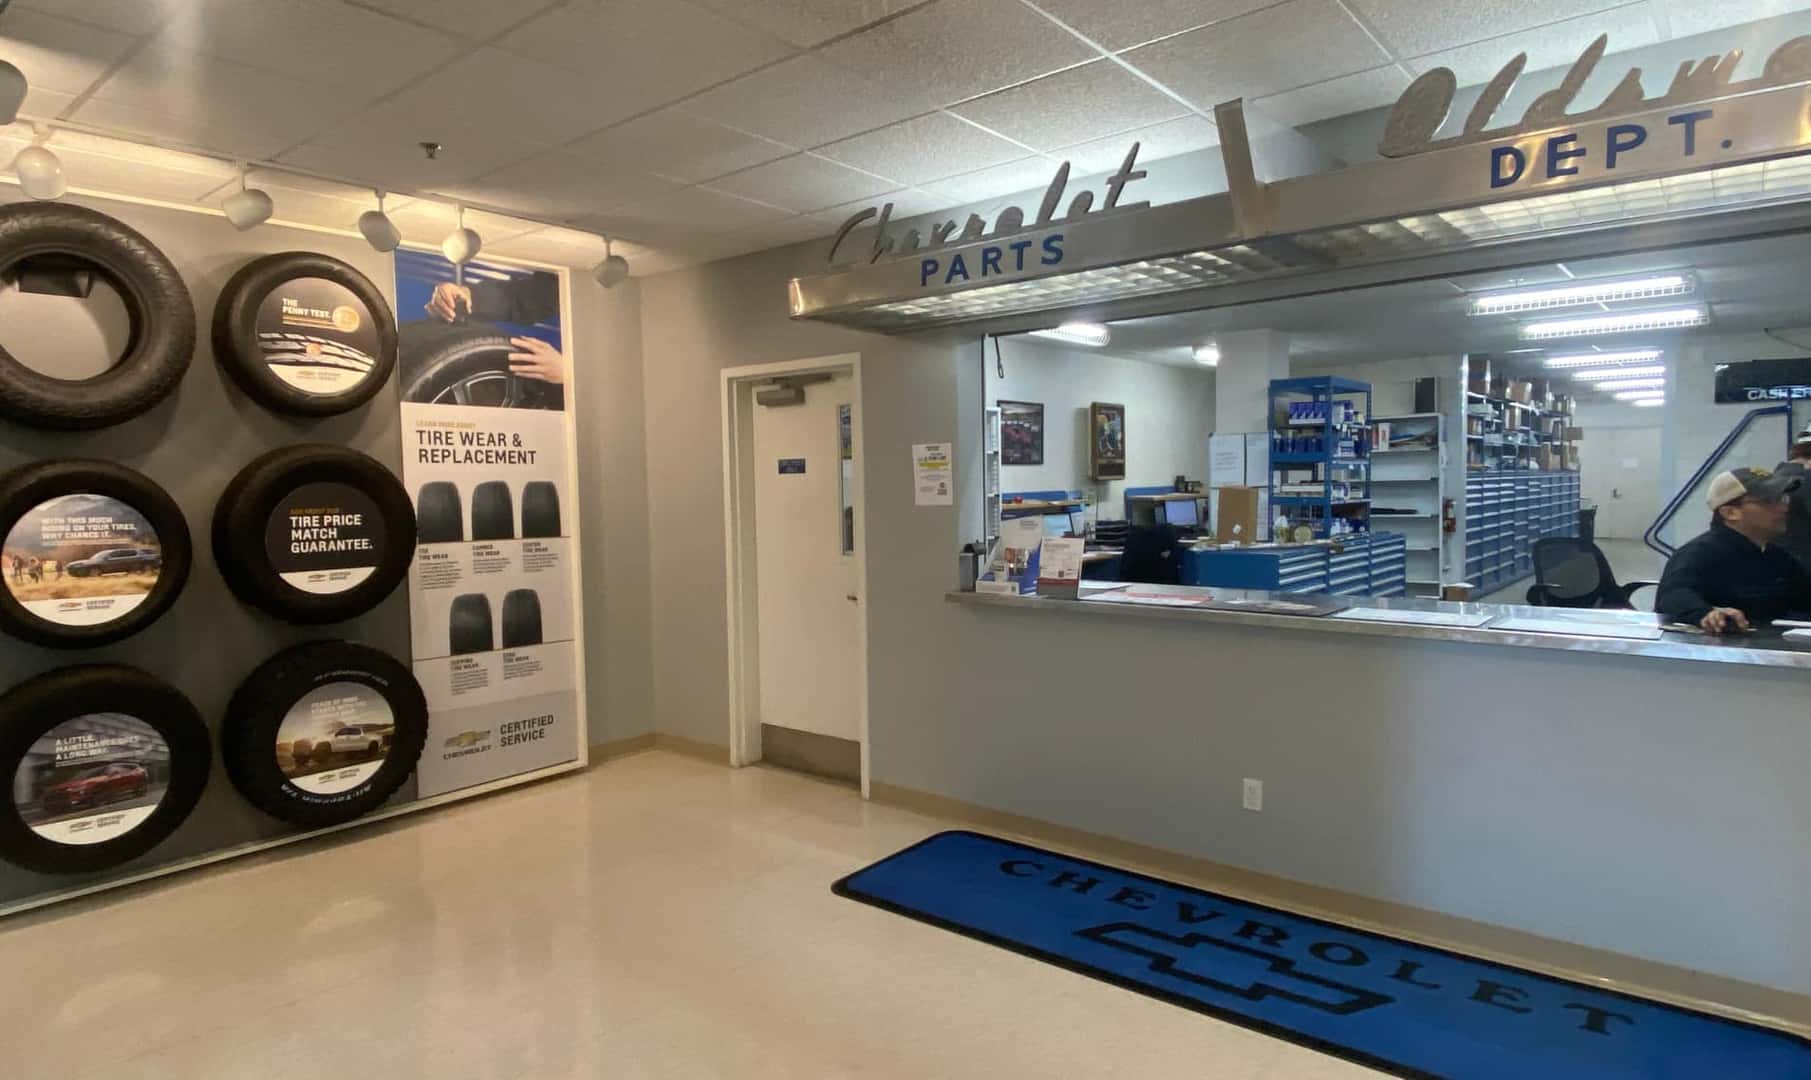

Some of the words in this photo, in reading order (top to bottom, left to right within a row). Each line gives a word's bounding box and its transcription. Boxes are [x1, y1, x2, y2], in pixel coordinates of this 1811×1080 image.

[828, 142, 1151, 264] Chevrolet
[920, 234, 1064, 286] PARTS
[1490, 110, 1733, 189] DEPT.
[282, 298, 298, 307] THE
[282, 306, 309, 316] PENNY
[1747, 386, 1811, 400] CASHER
[416, 430, 455, 446] TIRE
[460, 431, 507, 447] WEAR
[512, 433, 522, 448] &
[418, 448, 537, 465] REPLACEMENT
[289, 515, 320, 528] TIRE
[323, 514, 363, 526] PRICE
[291, 527, 338, 541] MATCH
[290, 538, 373, 554] GUARANTEE.
[500, 714, 555, 735] CERTIFIED
[500, 728, 546, 748] SERVICE
[999, 859, 1634, 1036] CHEVROLET
